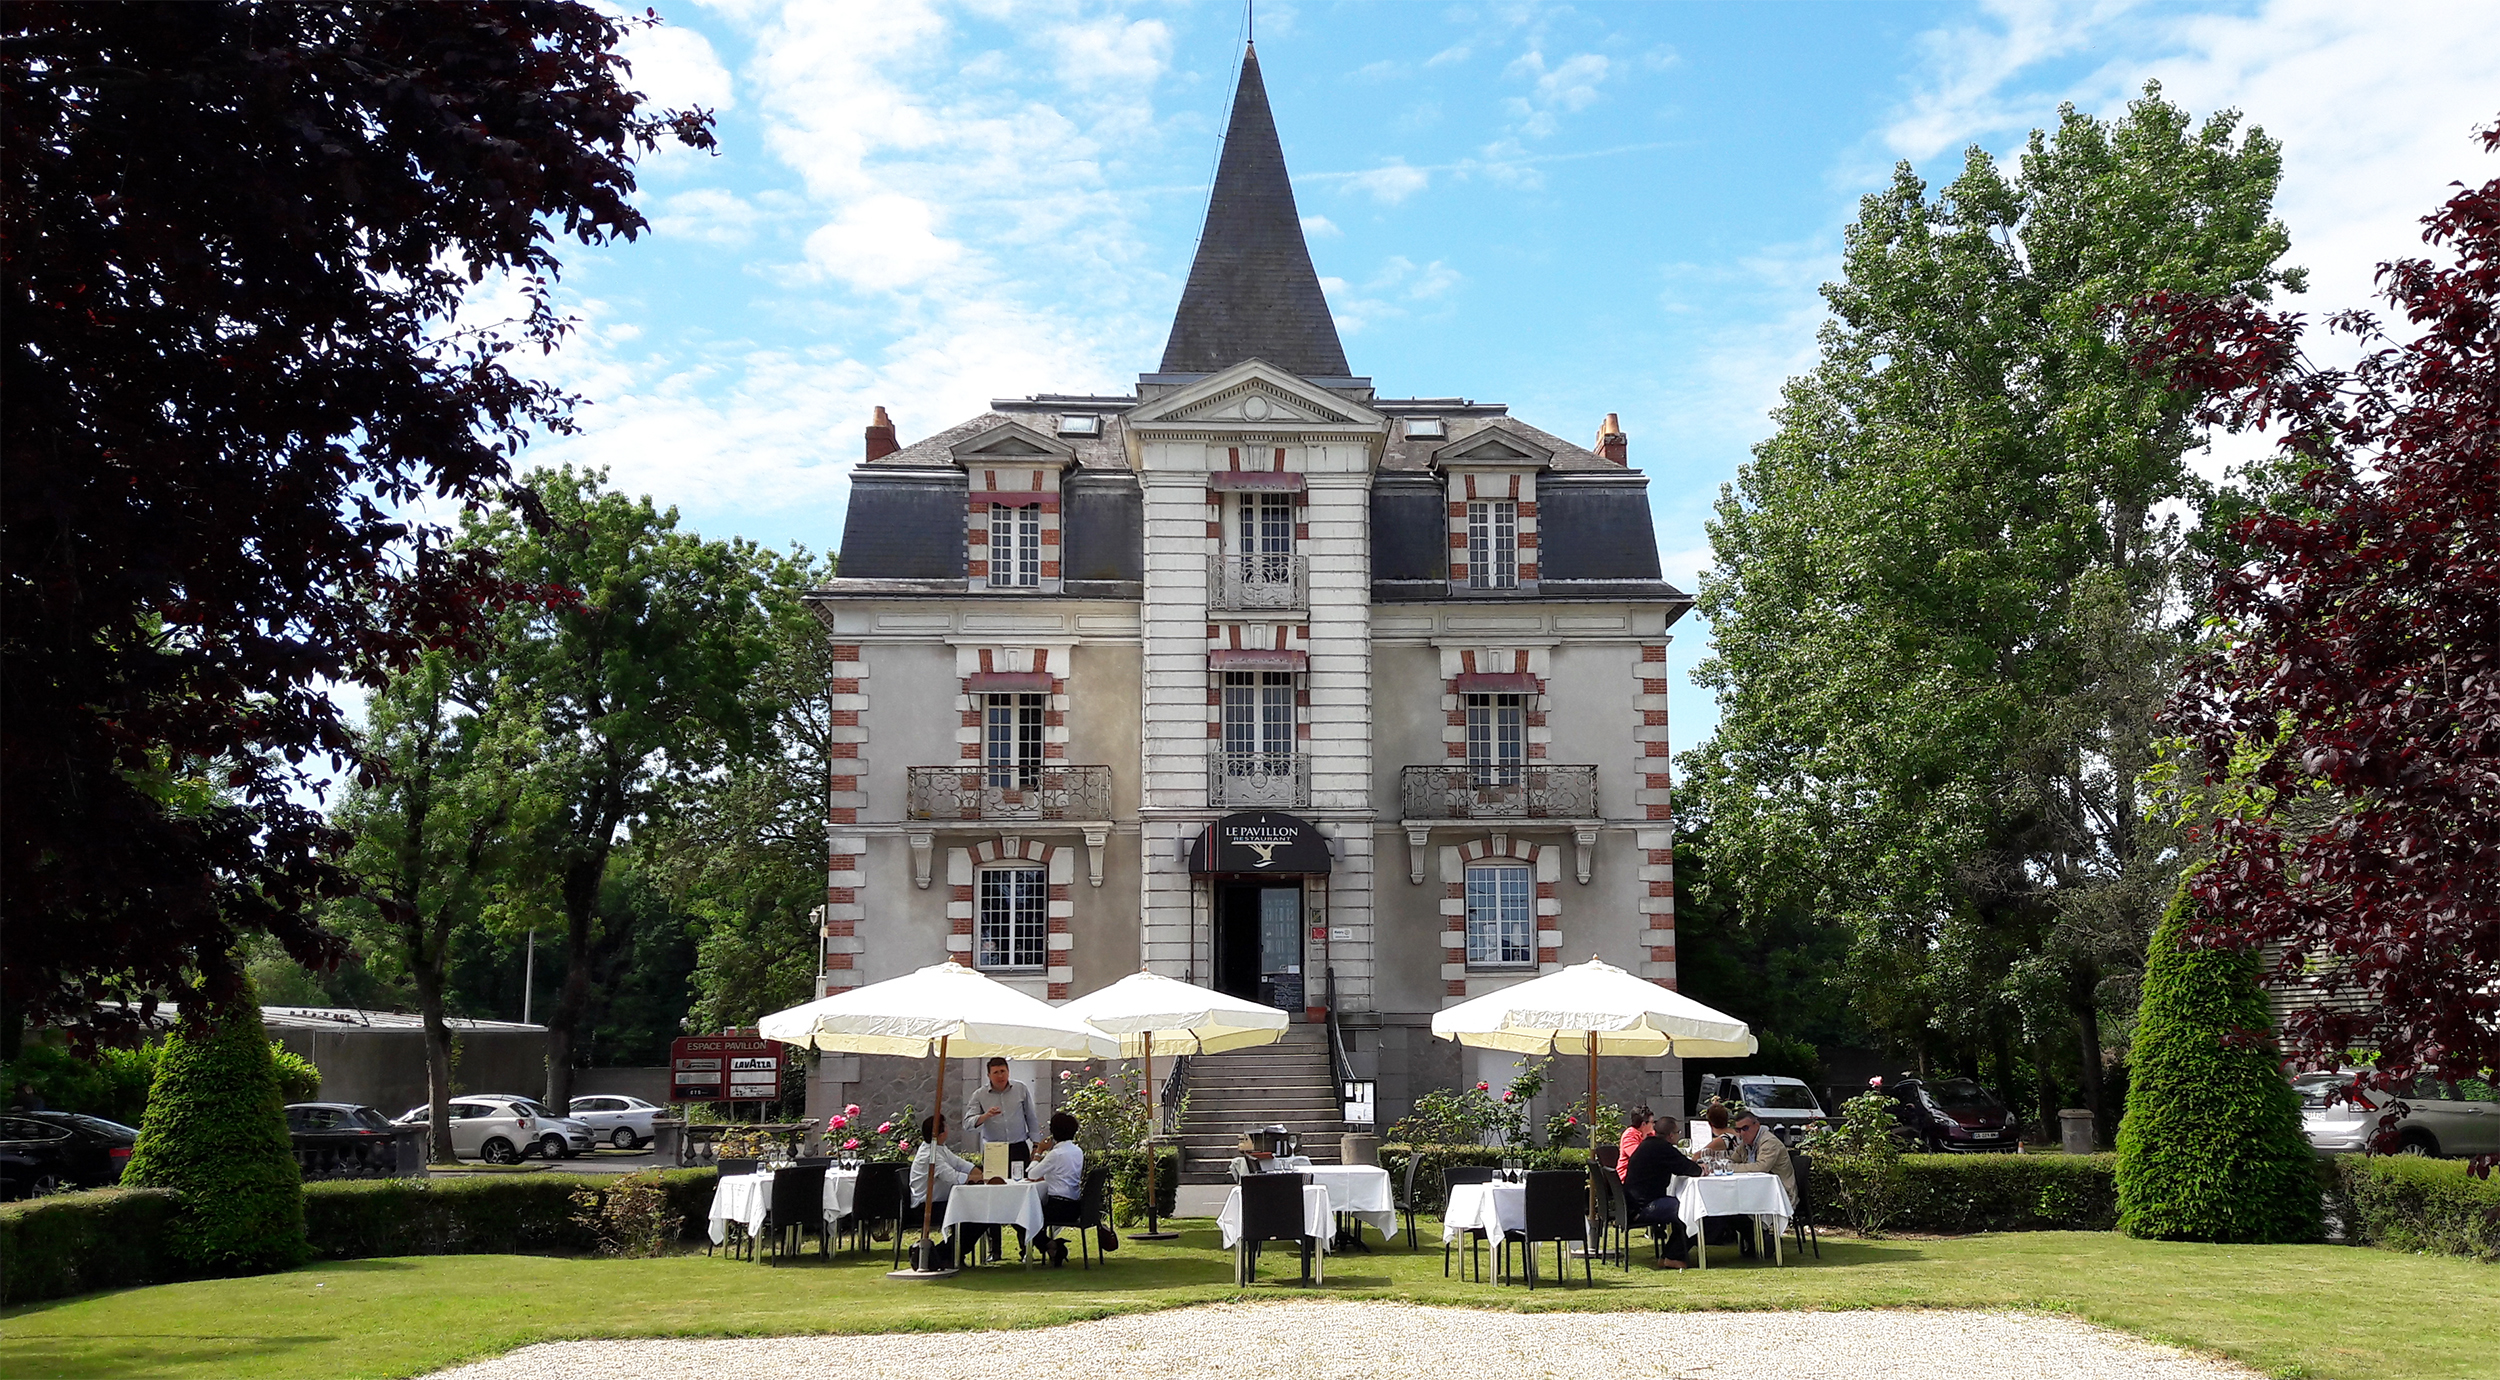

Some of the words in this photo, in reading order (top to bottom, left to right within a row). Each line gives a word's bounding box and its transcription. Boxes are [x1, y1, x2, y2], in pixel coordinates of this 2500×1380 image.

[1226, 827, 1238, 836] LE
[1240, 827, 1299, 836] PAVILLON
[687, 1042, 721, 1050] ESPACE
[724, 1041, 767, 1050] PAVILLON
[734, 1058, 772, 1069] LAVAZZA
